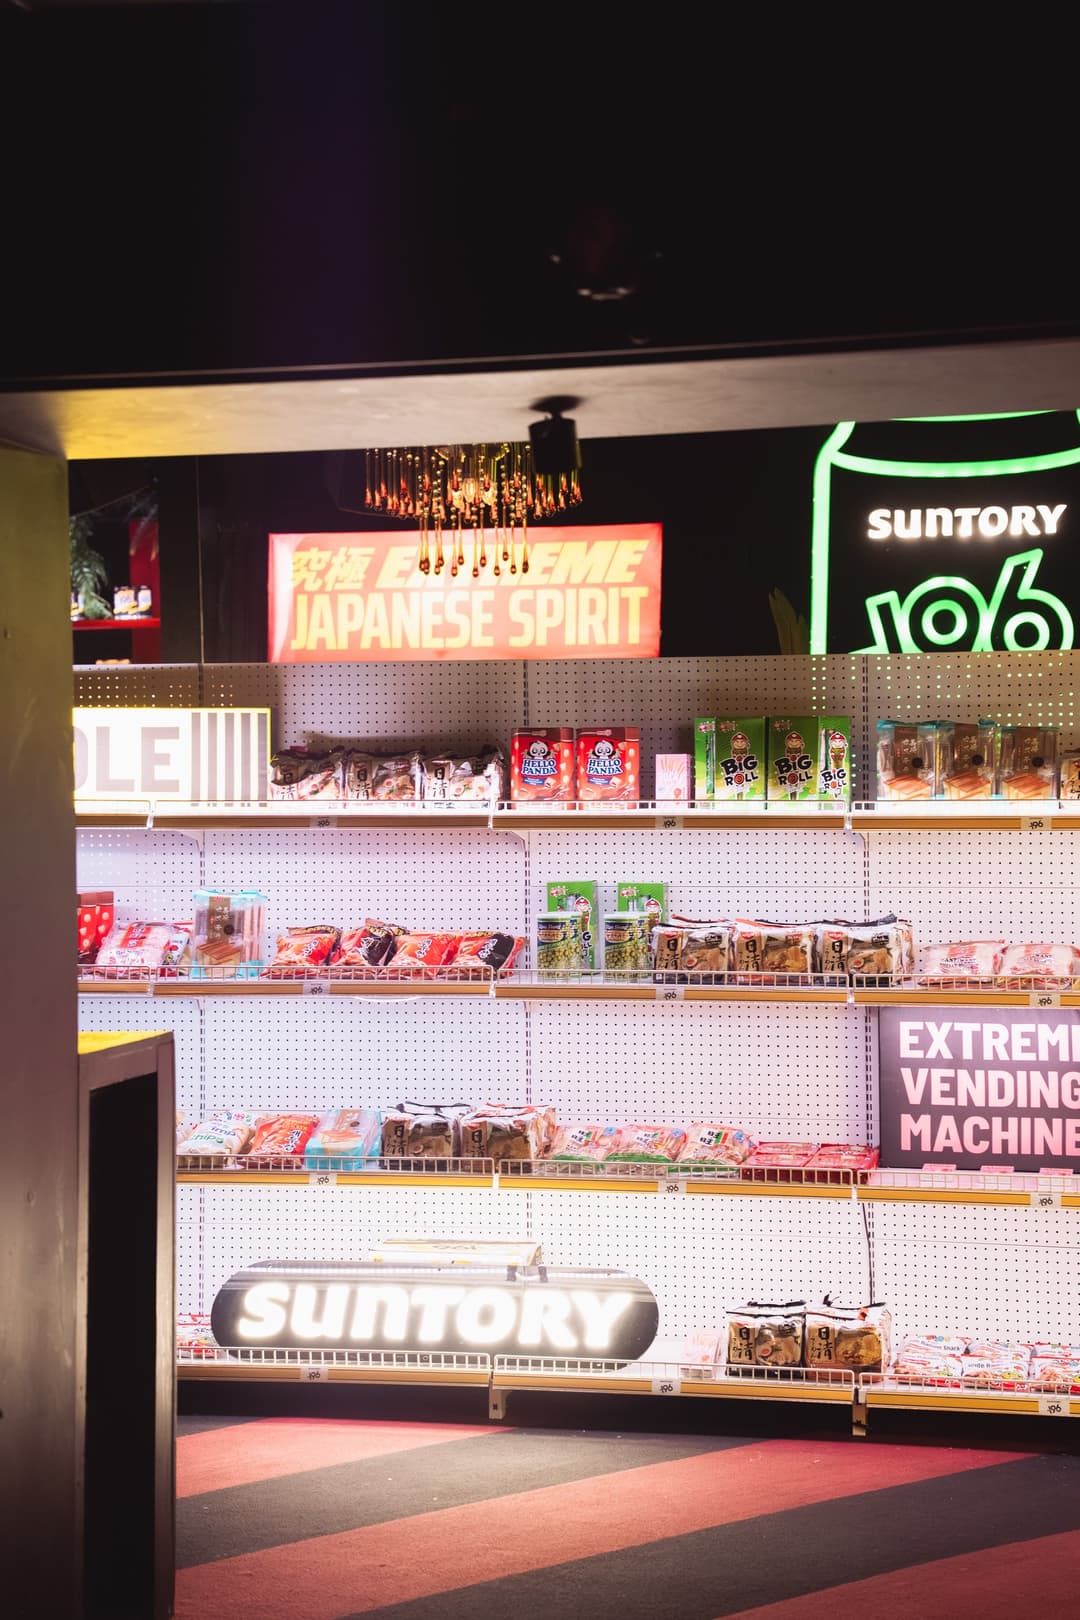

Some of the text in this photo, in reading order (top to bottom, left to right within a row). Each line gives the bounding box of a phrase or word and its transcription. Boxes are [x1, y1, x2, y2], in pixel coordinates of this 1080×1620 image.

[291, 586, 649, 651] JAPANESE SPIRIT
[524, 759, 555, 767] HELLO
[588, 759, 621, 767] HELLO
[720, 755, 758, 775] BIG
[775, 755, 812, 774] BIG
[724, 772, 758, 786] ROLL
[778, 772, 812, 785] ROLL
[821, 769, 846, 781] BIG
[900, 1068, 1080, 1110] VENDING
[901, 1113, 1080, 1156] MACHINE
